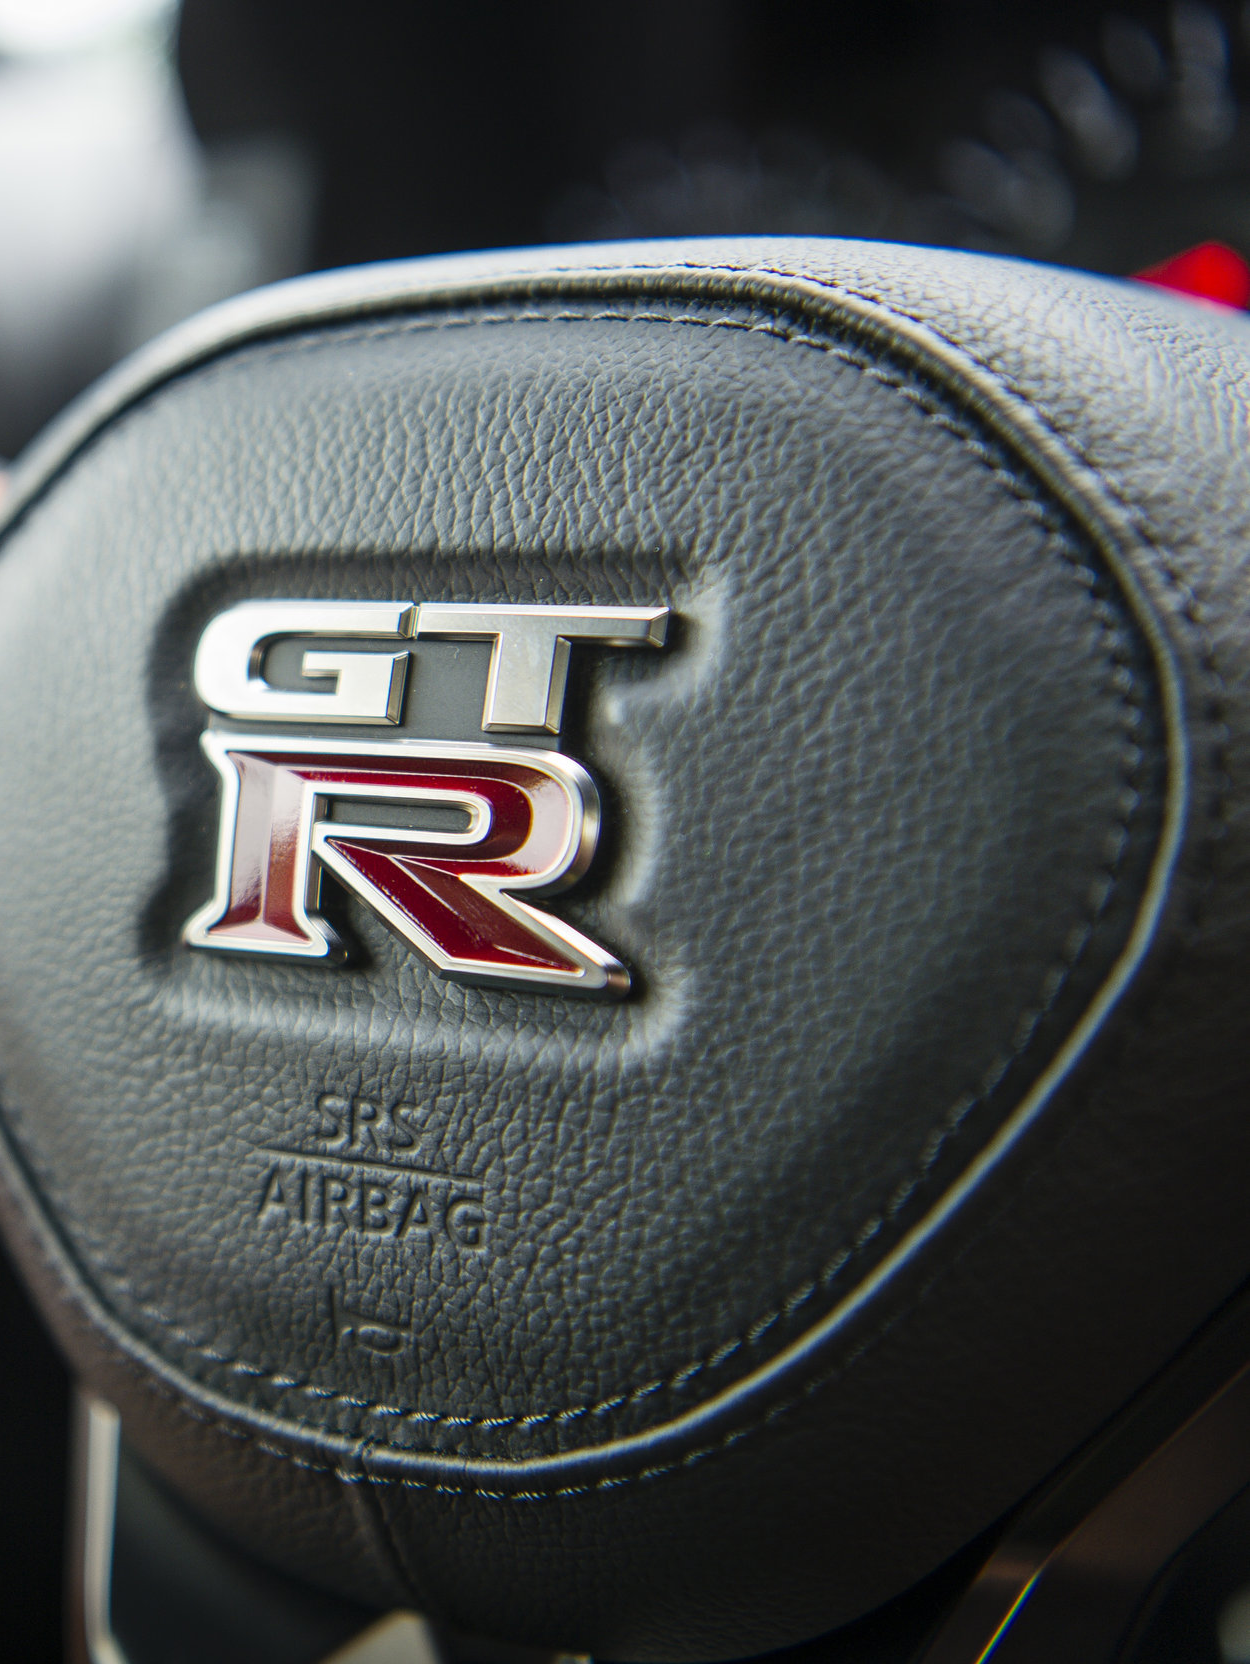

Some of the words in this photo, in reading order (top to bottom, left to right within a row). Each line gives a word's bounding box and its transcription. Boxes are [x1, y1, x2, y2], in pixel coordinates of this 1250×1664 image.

[194, 598, 670, 735] GT
[183, 730, 633, 996] R
[314, 1092, 422, 1157] SRS
[255, 1160, 488, 1253] AIRBAG
